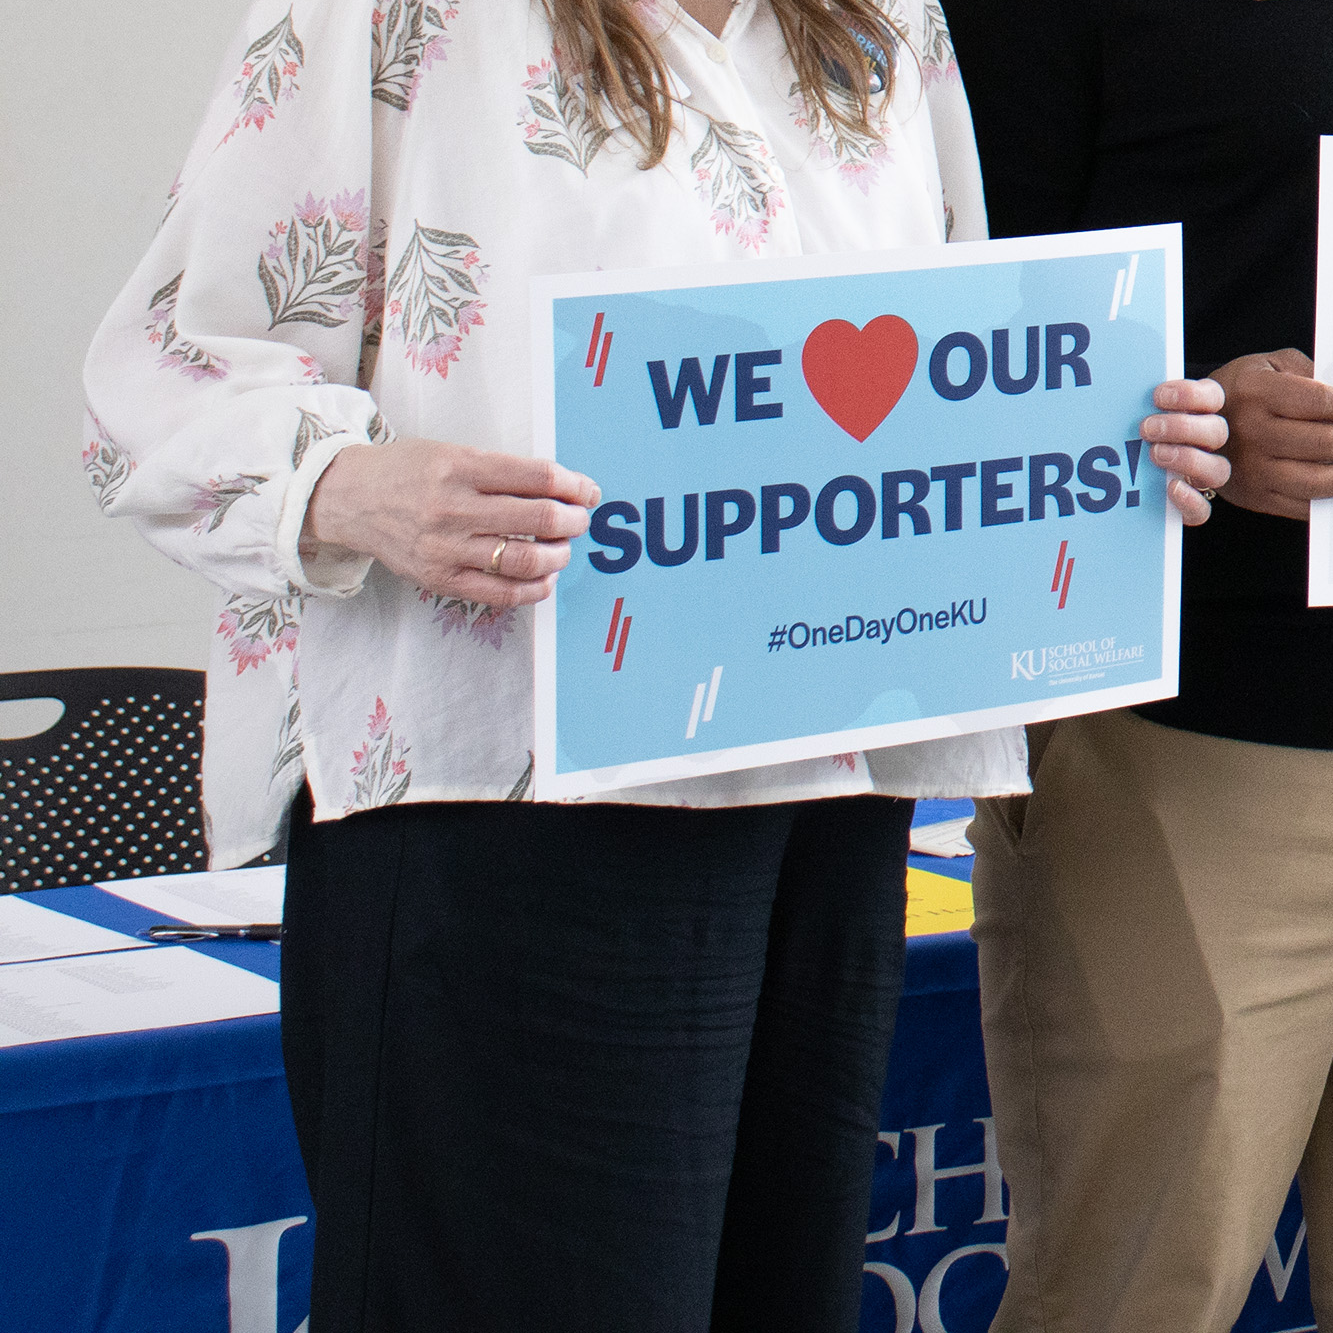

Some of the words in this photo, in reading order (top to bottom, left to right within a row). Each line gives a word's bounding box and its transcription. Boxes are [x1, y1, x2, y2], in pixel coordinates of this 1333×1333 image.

[646, 349, 783, 429] WE
[928, 321, 1092, 401] OUR
[588, 439, 1142, 575] SUPPORTERS!
[767, 598, 988, 653] #OneDayOneKU
[1047, 640, 1098, 659] SCHOOL
[1100, 636, 1116, 650] OF
[1010, 647, 1047, 681] KU
[1047, 651, 1092, 673] SOCIAL
[1094, 645, 1144, 664] WELFARE
